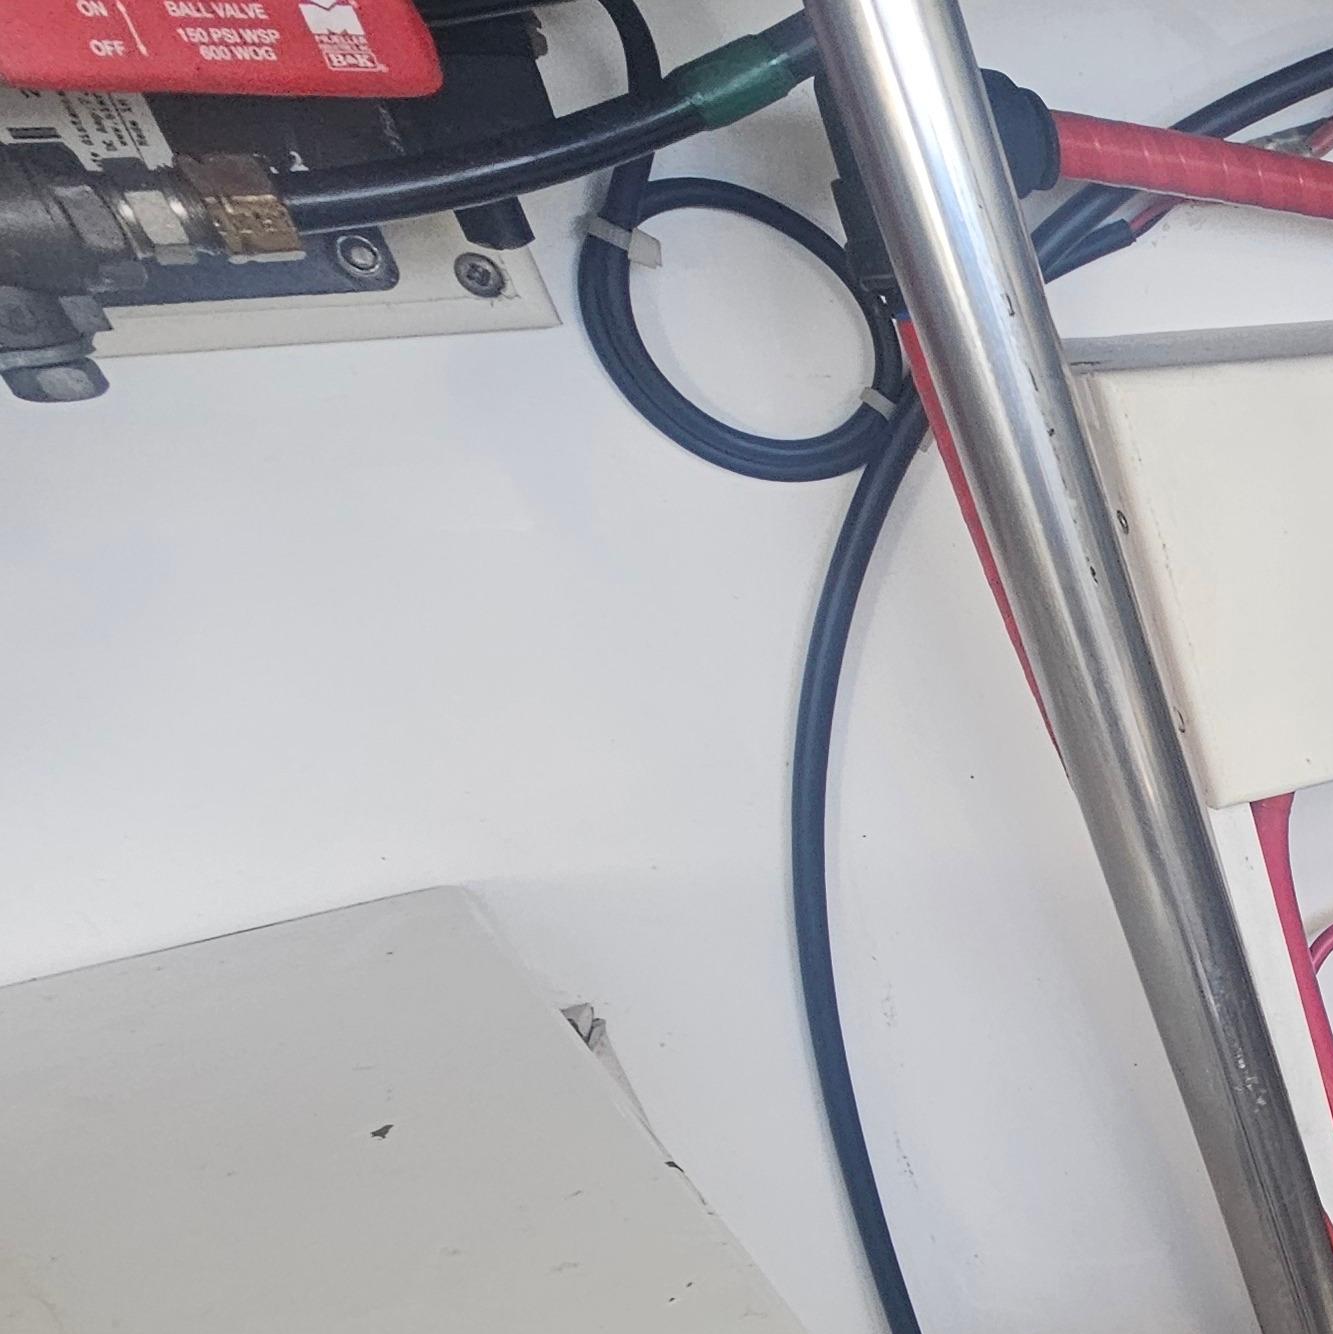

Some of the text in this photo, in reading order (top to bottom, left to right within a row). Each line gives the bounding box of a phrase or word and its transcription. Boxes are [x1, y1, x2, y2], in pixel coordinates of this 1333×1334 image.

[77, 0, 108, 17] ON
[164, 0, 269, 20] BALL VALVE
[176, 27, 280, 44] 150 PSI WSP
[88, 40, 125, 56] OFF
[199, 46, 278, 61] 600 WOG
